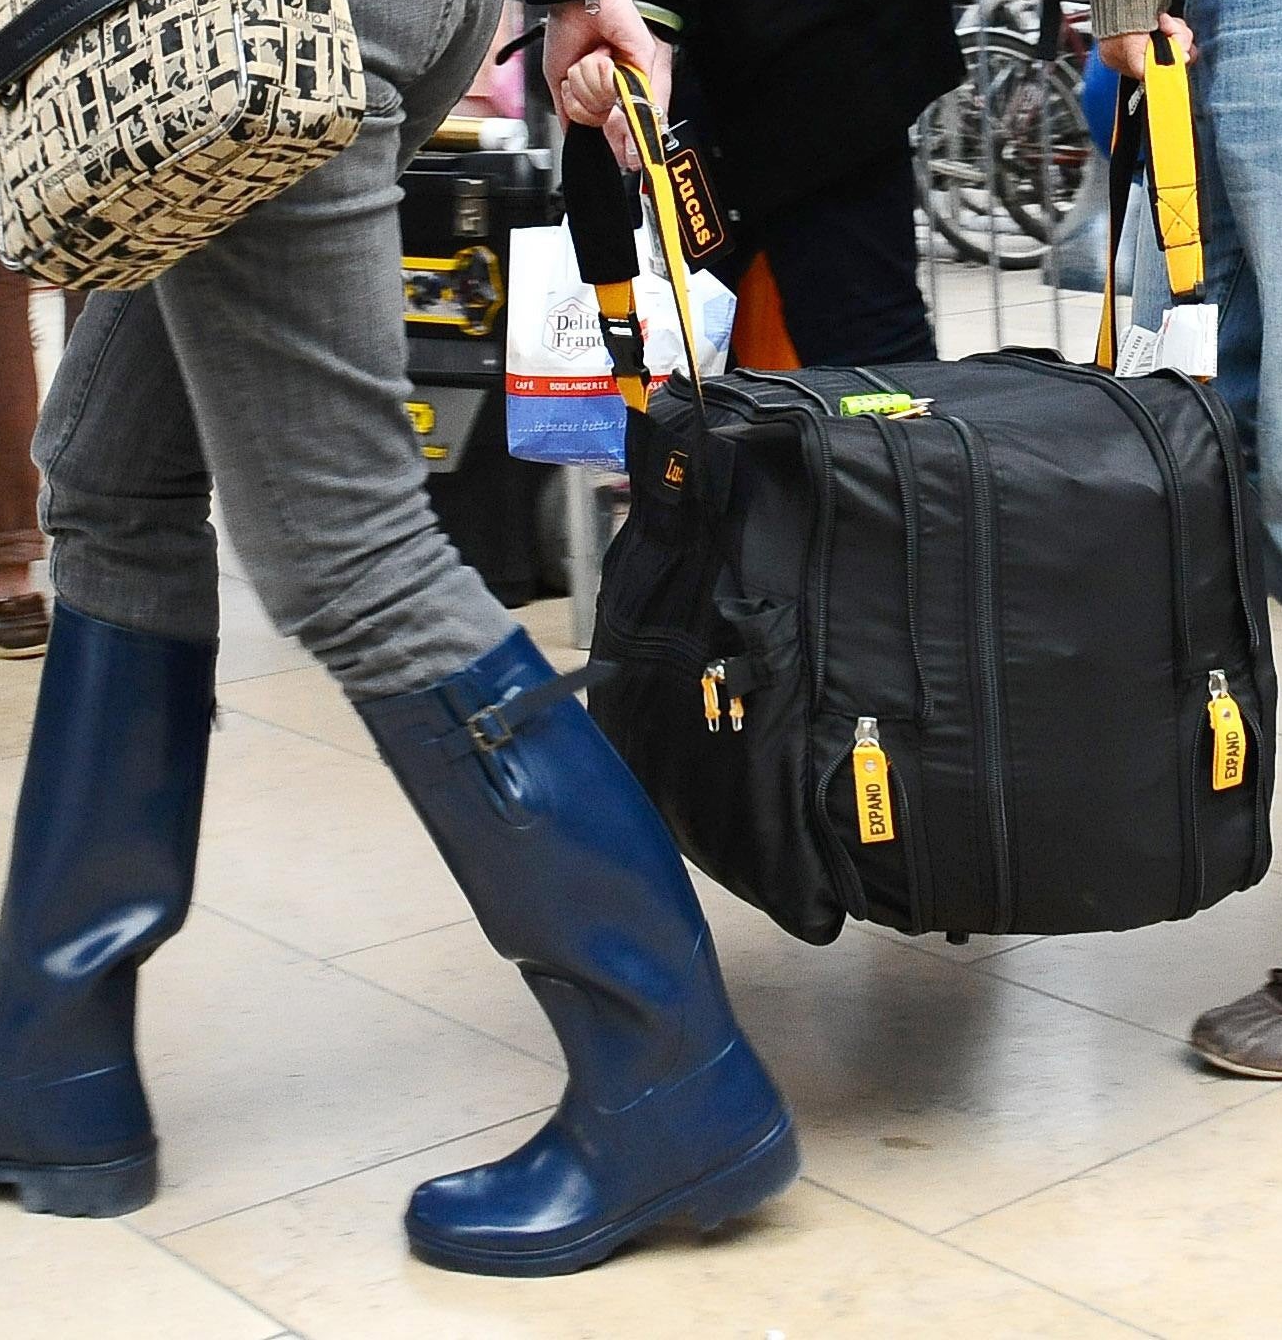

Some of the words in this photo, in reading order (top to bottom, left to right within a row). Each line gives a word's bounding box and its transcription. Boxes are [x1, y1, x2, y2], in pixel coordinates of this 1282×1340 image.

[671, 159, 712, 246] Lucas
[515, 380, 534, 390] CAFÉ
[549, 381, 608, 391] BOULANGERIE
[582, 419, 616, 431] better
[1225, 731, 1239, 780] EXPAND
[866, 783, 886, 836] EXPAND
